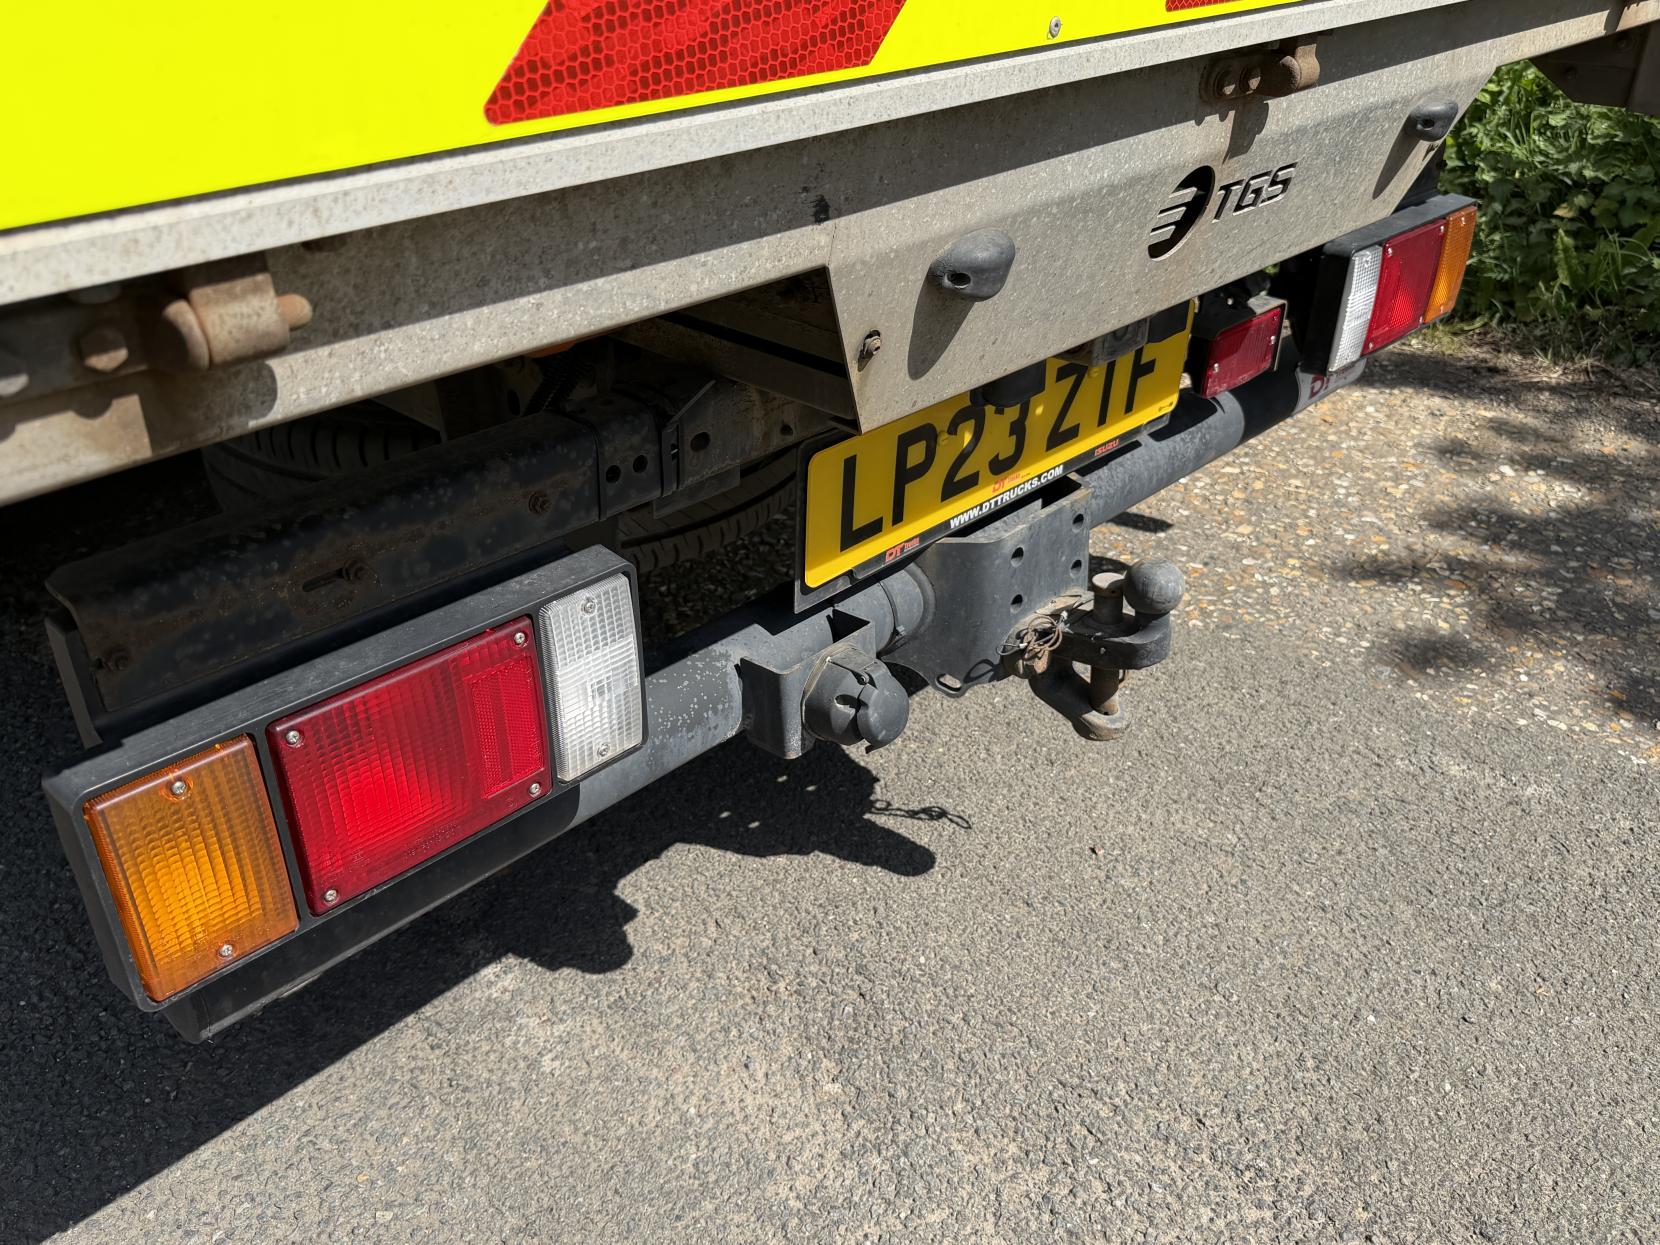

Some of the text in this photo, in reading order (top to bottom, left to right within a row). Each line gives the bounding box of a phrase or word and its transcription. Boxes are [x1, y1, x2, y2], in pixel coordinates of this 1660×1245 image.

[1212, 162, 1298, 223] TGS
[840, 401, 1030, 552] LP23
[1094, 439, 1120, 456] ISUZU
[950, 465, 1064, 529] WWW.DTTRUCKS.COM
[886, 543, 905, 561] DT
